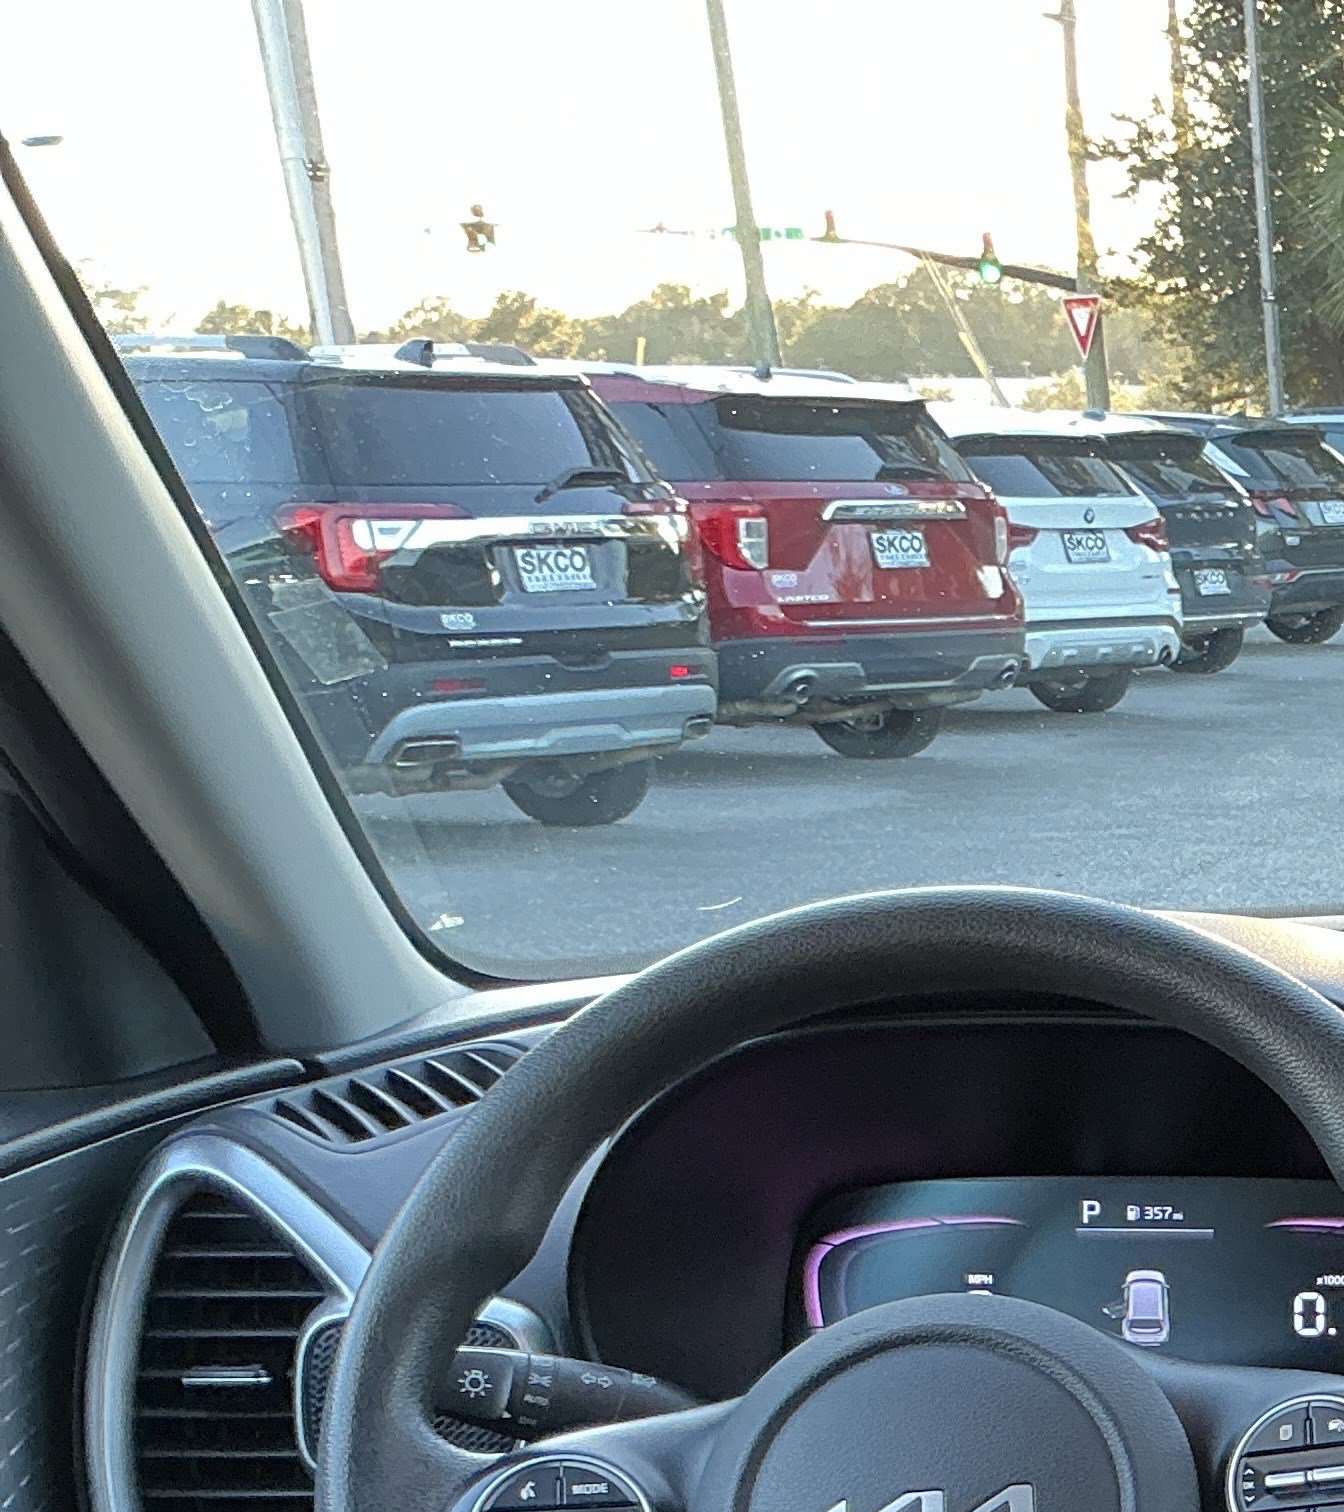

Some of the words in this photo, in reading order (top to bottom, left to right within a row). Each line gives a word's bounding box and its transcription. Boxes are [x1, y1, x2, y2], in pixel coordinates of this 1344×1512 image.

[875, 535, 923, 554] SKCO
[1066, 535, 1106, 551] SKCO
[520, 551, 587, 575] SKCO
[1082, 1200, 1101, 1224] P
[1144, 1206, 1173, 1220] 357
[968, 1274, 994, 1285] MPH
